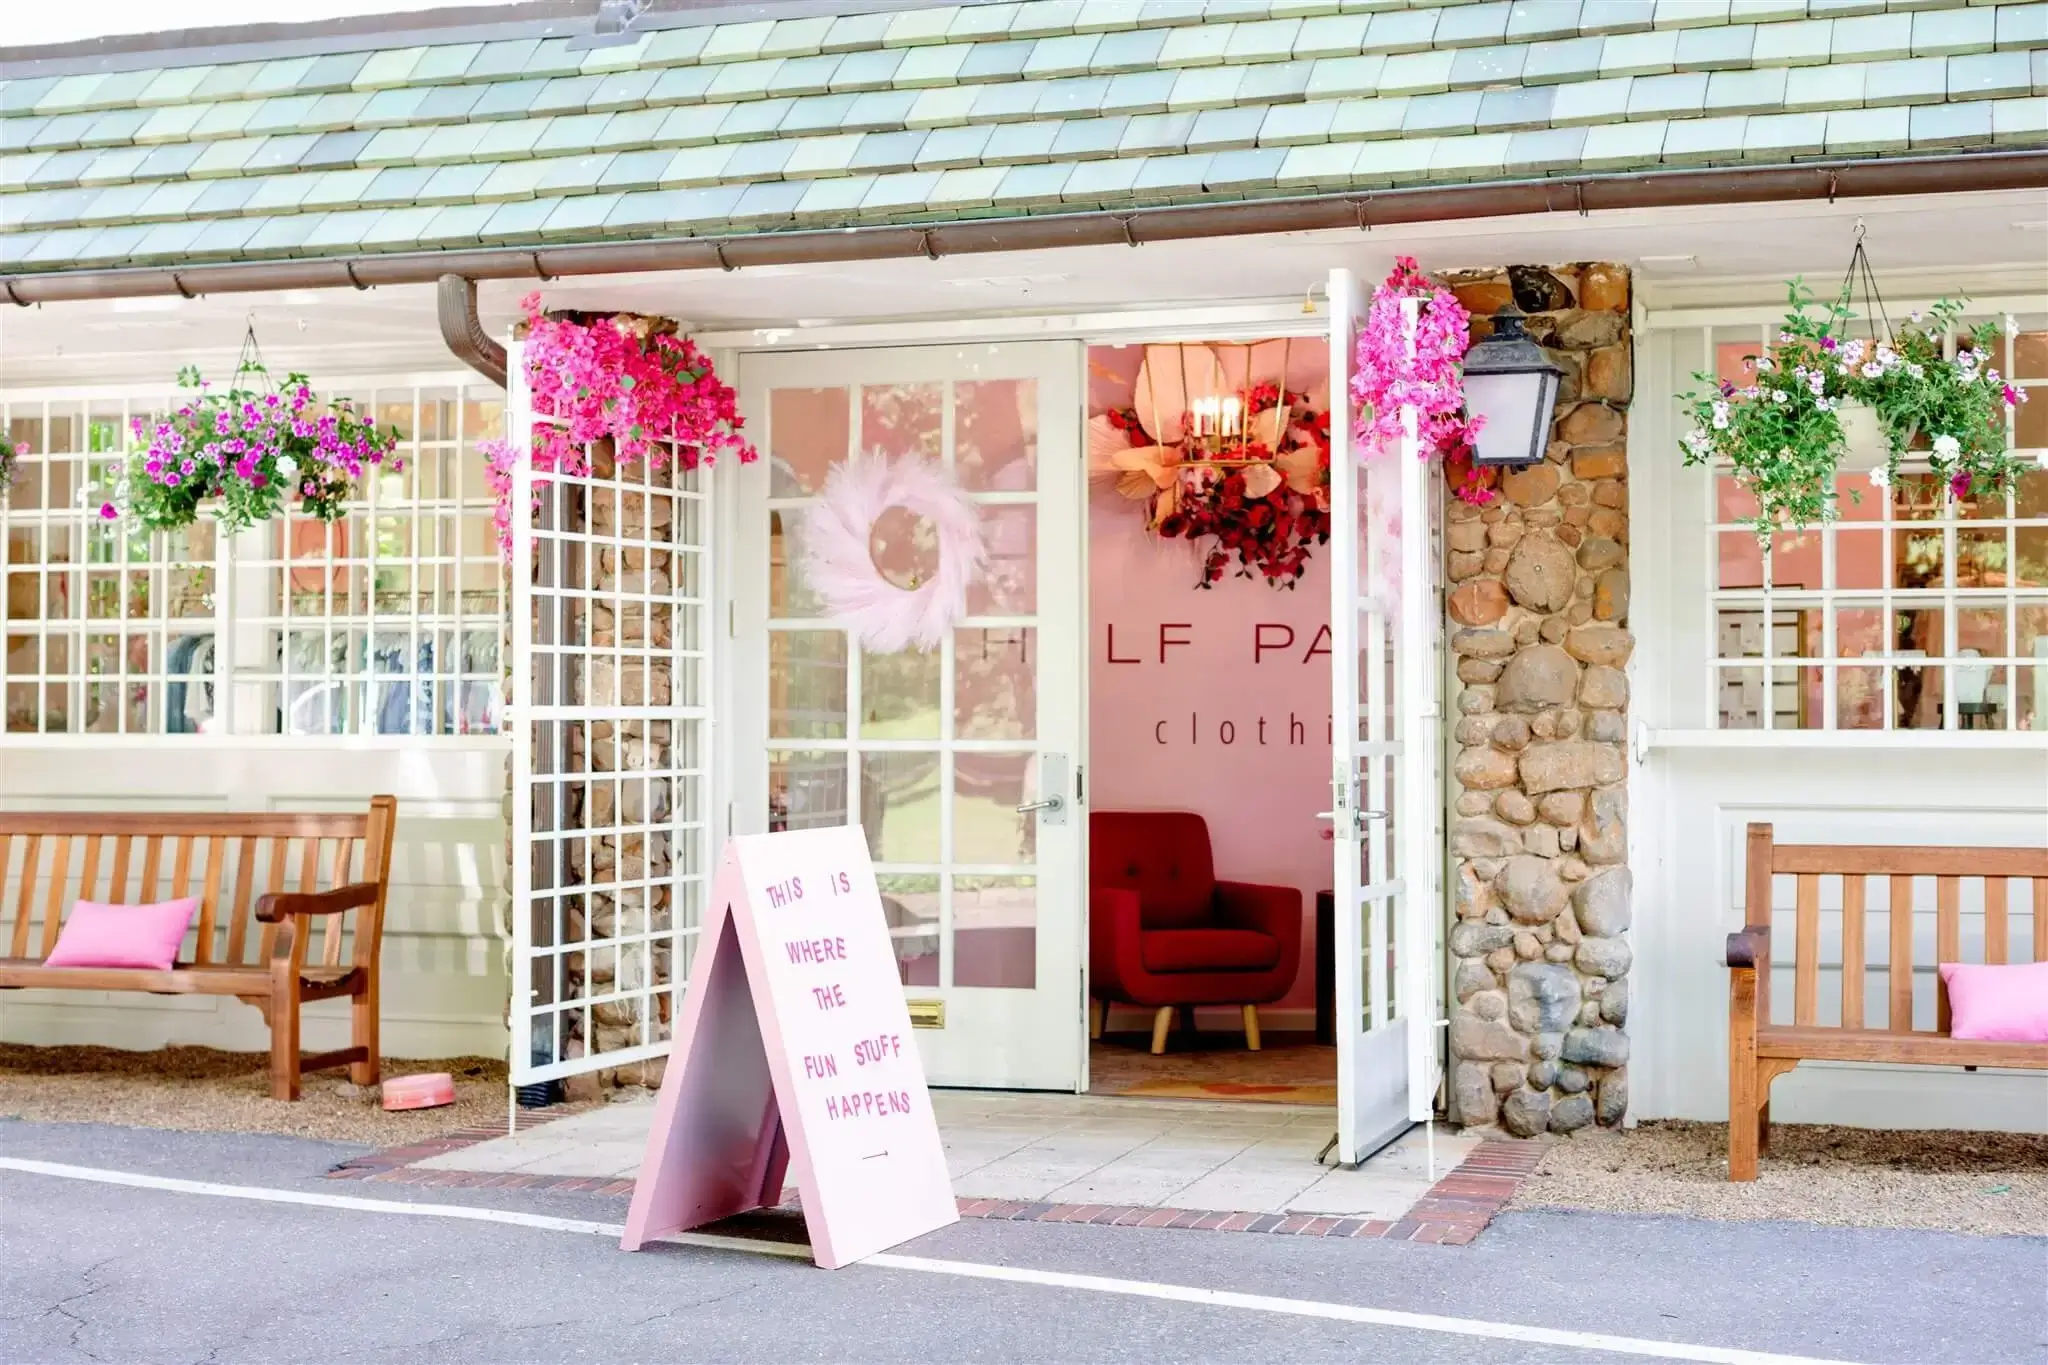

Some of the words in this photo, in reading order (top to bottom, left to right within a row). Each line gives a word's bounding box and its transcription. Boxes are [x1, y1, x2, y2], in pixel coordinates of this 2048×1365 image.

[983, 623, 1193, 664] HLF
[766, 876, 804, 909] THIS
[832, 872, 851, 896] IS
[785, 937, 847, 964] WHERE
[812, 984, 846, 1010] THE
[805, 1054, 838, 1079] FUN
[854, 1034, 901, 1066] STUFF
[825, 1091, 911, 1120] HAPPENS
